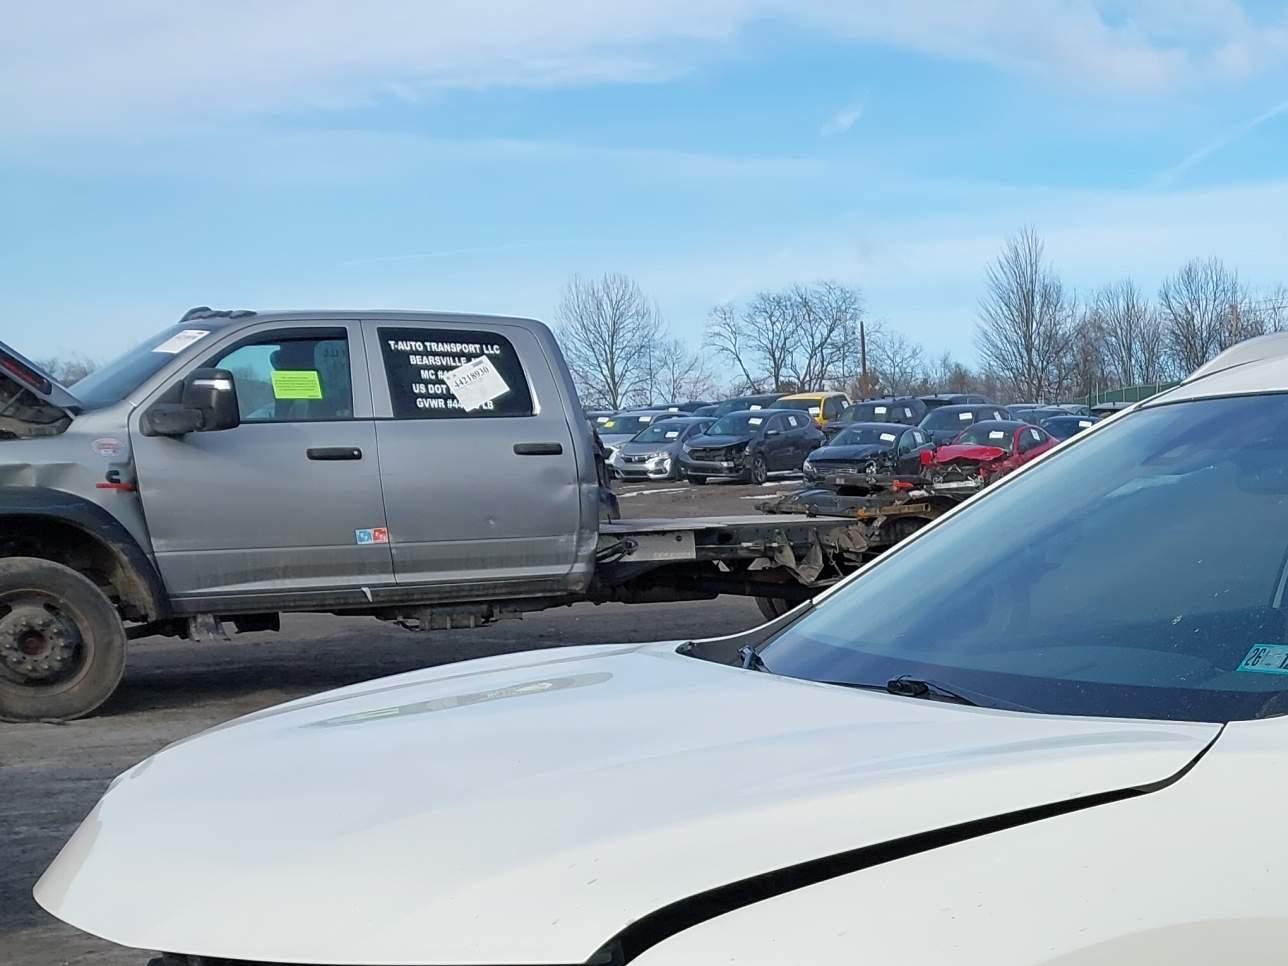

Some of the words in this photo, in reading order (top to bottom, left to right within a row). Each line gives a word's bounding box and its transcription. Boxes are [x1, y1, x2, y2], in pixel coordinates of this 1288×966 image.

[389, 341, 423, 351] T-AUTO
[425, 343, 480, 354] TRANSPORT
[483, 345, 500, 354] LLC
[421, 370, 435, 379] MC
[454, 366, 490, 389] 44218930
[413, 384, 426, 394] US
[428, 385, 447, 394] DOT
[416, 399, 445, 408] GVWR
